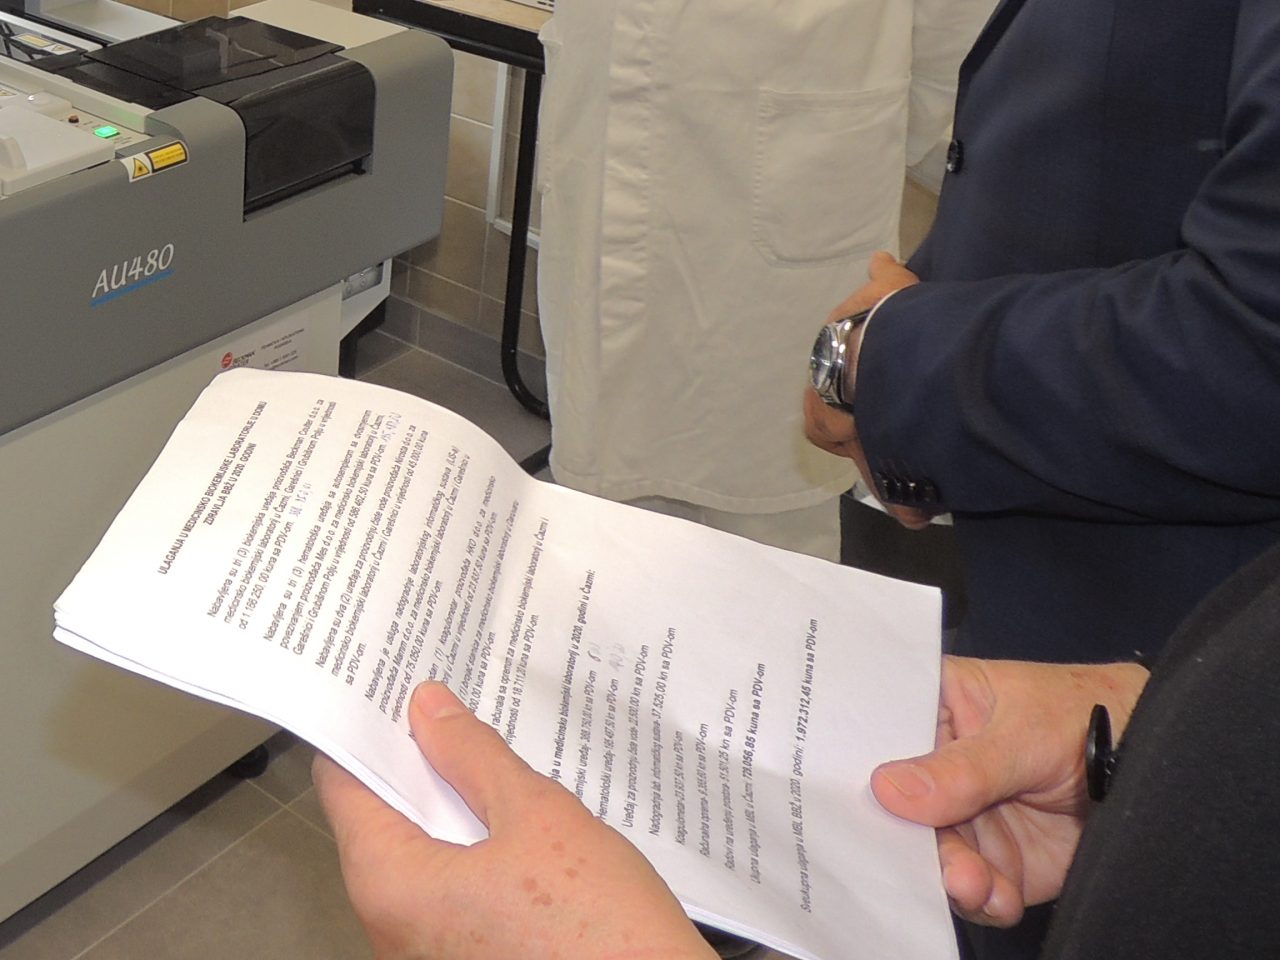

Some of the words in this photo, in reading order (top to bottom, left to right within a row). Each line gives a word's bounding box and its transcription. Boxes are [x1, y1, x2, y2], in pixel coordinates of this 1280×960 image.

[92, 243, 175, 299] AU480
[297, 418, 314, 436] Coulter
[353, 409, 372, 439] dvosmjernim
[285, 436, 305, 460] Beckman
[358, 433, 378, 460] laboratorij
[394, 445, 409, 465] Nirosta
[445, 445, 461, 467] (LIS-a)
[202, 495, 228, 526] ZDRAVLJA
[220, 481, 236, 495] BBŽ
[239, 442, 257, 462] GODINI
[272, 459, 293, 491] proizvođača
[331, 449, 354, 489] autosemplerom
[345, 458, 366, 489] biokemijski
[361, 472, 375, 488] kuna
[383, 464, 402, 499] proizvođača
[439, 466, 452, 490] sustava
[157, 538, 186, 575] ULAGANJA
[182, 496, 211, 533] MEDICINSKO
[204, 455, 234, 497] BIOKEMIJSKE
[228, 417, 257, 459] LABORATORIJE
[261, 491, 278, 511] uređaja
[327, 490, 337, 499] sa
[334, 487, 353, 520] medicinsko
[348, 486, 369, 519] 586.462,50
[377, 496, 389, 512] vode
[482, 475, 497, 508] medicinsko
[223, 584, 247, 624] medicinsko
[240, 548, 265, 585] biokemijski
[257, 517, 281, 549] laboratorij
[283, 469, 303, 494] Garešnici
[297, 439, 318, 467] Grubišnom
[310, 427, 325, 440] Polju
[320, 401, 337, 423] vrijednosti
[317, 500, 333, 523] uređaja
[330, 519, 340, 529] za
[346, 517, 356, 528] od
[369, 510, 383, 527] čiste
[425, 489, 446, 530] informatičkog
[241, 512, 266, 547] biokemijska
[296, 524, 322, 565] hematološka
[334, 525, 352, 559] vrijednosti
[358, 524, 379, 562] proizvodnju
[533, 520, 549, 542] Čazmi
[232, 558, 243, 567] tri
[236, 547, 250, 559] (3)
[314, 546, 329, 562] Mes
[331, 635, 352, 677] medicinsko
[344, 596, 366, 637] biokemijski
[358, 564, 380, 599] laboratorij
[370, 539, 388, 561] Čazmi
[381, 508, 399, 537] Garešnici
[395, 475, 412, 505] vrijednosti
[407, 441, 424, 469] 45.000,00
[416, 430, 429, 444] kuna
[408, 529, 432, 576] laboratorijskog
[465, 538, 477, 557] HKO
[525, 545, 544, 577] laboratorij
[228, 567, 239, 578] su
[291, 566, 305, 578] (3)
[322, 563, 338, 582] Polju
[354, 559, 364, 570] za
[454, 557, 472, 600] proizvođača
[238, 618, 249, 630] od
[262, 556, 278, 574] kuna
[272, 547, 282, 557] sa
[283, 589, 293, 600] su
[287, 577, 297, 588] tri
[299, 561, 322, 603] proizvođača
[345, 568, 362, 594] uređaja
[378, 665, 400, 715] proizvođača
[392, 639, 408, 668] Mamm
[401, 620, 415, 642] d.o.o.
[412, 572, 431, 611] medicinsko
[423, 537, 442, 575] biokemijski
[434, 508, 454, 541] laboratorij
[444, 485, 459, 506] Čazmi
[453, 458, 469, 485] Garešnici
[516, 574, 534, 611] biokemijski
[579, 569, 596, 595] Čazmi:
[206, 578, 233, 618] Nabavljena
[307, 580, 330, 619] Grubišnom
[335, 603, 347, 618] dva
[339, 592, 353, 606] (2)
[394, 576, 415, 620] nadogradnje
[443, 639, 460, 666] Čazmi
[455, 598, 472, 637] vrijednosti
[477, 544, 488, 563] kuna
[477, 592, 494, 632] medicinsko
[576, 599, 588, 625] godini
[262, 602, 288, 642] Nabavljena
[279, 601, 305, 650] povezivanjem
[332, 616, 342, 628] su
[385, 620, 400, 646] usluga
[437, 597, 458, 646] koagulometar
[508, 609, 525, 649] medicinsko
[570, 624, 584, 645] 2020.
[804, 618, 818, 652] PDV-om
[292, 621, 314, 656] Garešnici
[314, 626, 338, 669] Nabavljena
[433, 646, 448, 663] (1)
[660, 627, 677, 660] PDV-om
[346, 642, 366, 676] PDV-om.
[390, 680, 409, 724] vrijednosti
[405, 634, 426, 674] 75.050,00
[417, 617, 431, 638] kuna
[500, 656, 513, 685] opremom
[517, 652, 530, 669] kuna
[561, 648, 581, 686] laboratorij
[805, 652, 815, 664] sa
[345, 674, 355, 686] sa
[364, 658, 386, 702] Nabavljena
[473, 669, 486, 689] kuna
[583, 669, 597, 697] PDV-om
[751, 663, 766, 698] PDV-om
[801, 663, 814, 686] kuna
[558, 683, 573, 718] biokemijski
[605, 678, 619, 706] PDV-om
[650, 680, 667, 720] 37.525,00
[723, 688, 738, 725] PDV-om
[490, 694, 506, 727] računala
[746, 711, 760, 736] kuna
[795, 684, 813, 742] 1.972.312,45
[553, 716, 568, 760] medicinsko
[621, 800, 639, 828] Uređaj
[633, 644, 650, 677] PDV-om
[694, 723, 709, 755] PDV-om
[791, 743, 805, 777] godini:
[648, 791, 664, 837] Nadogradnja
